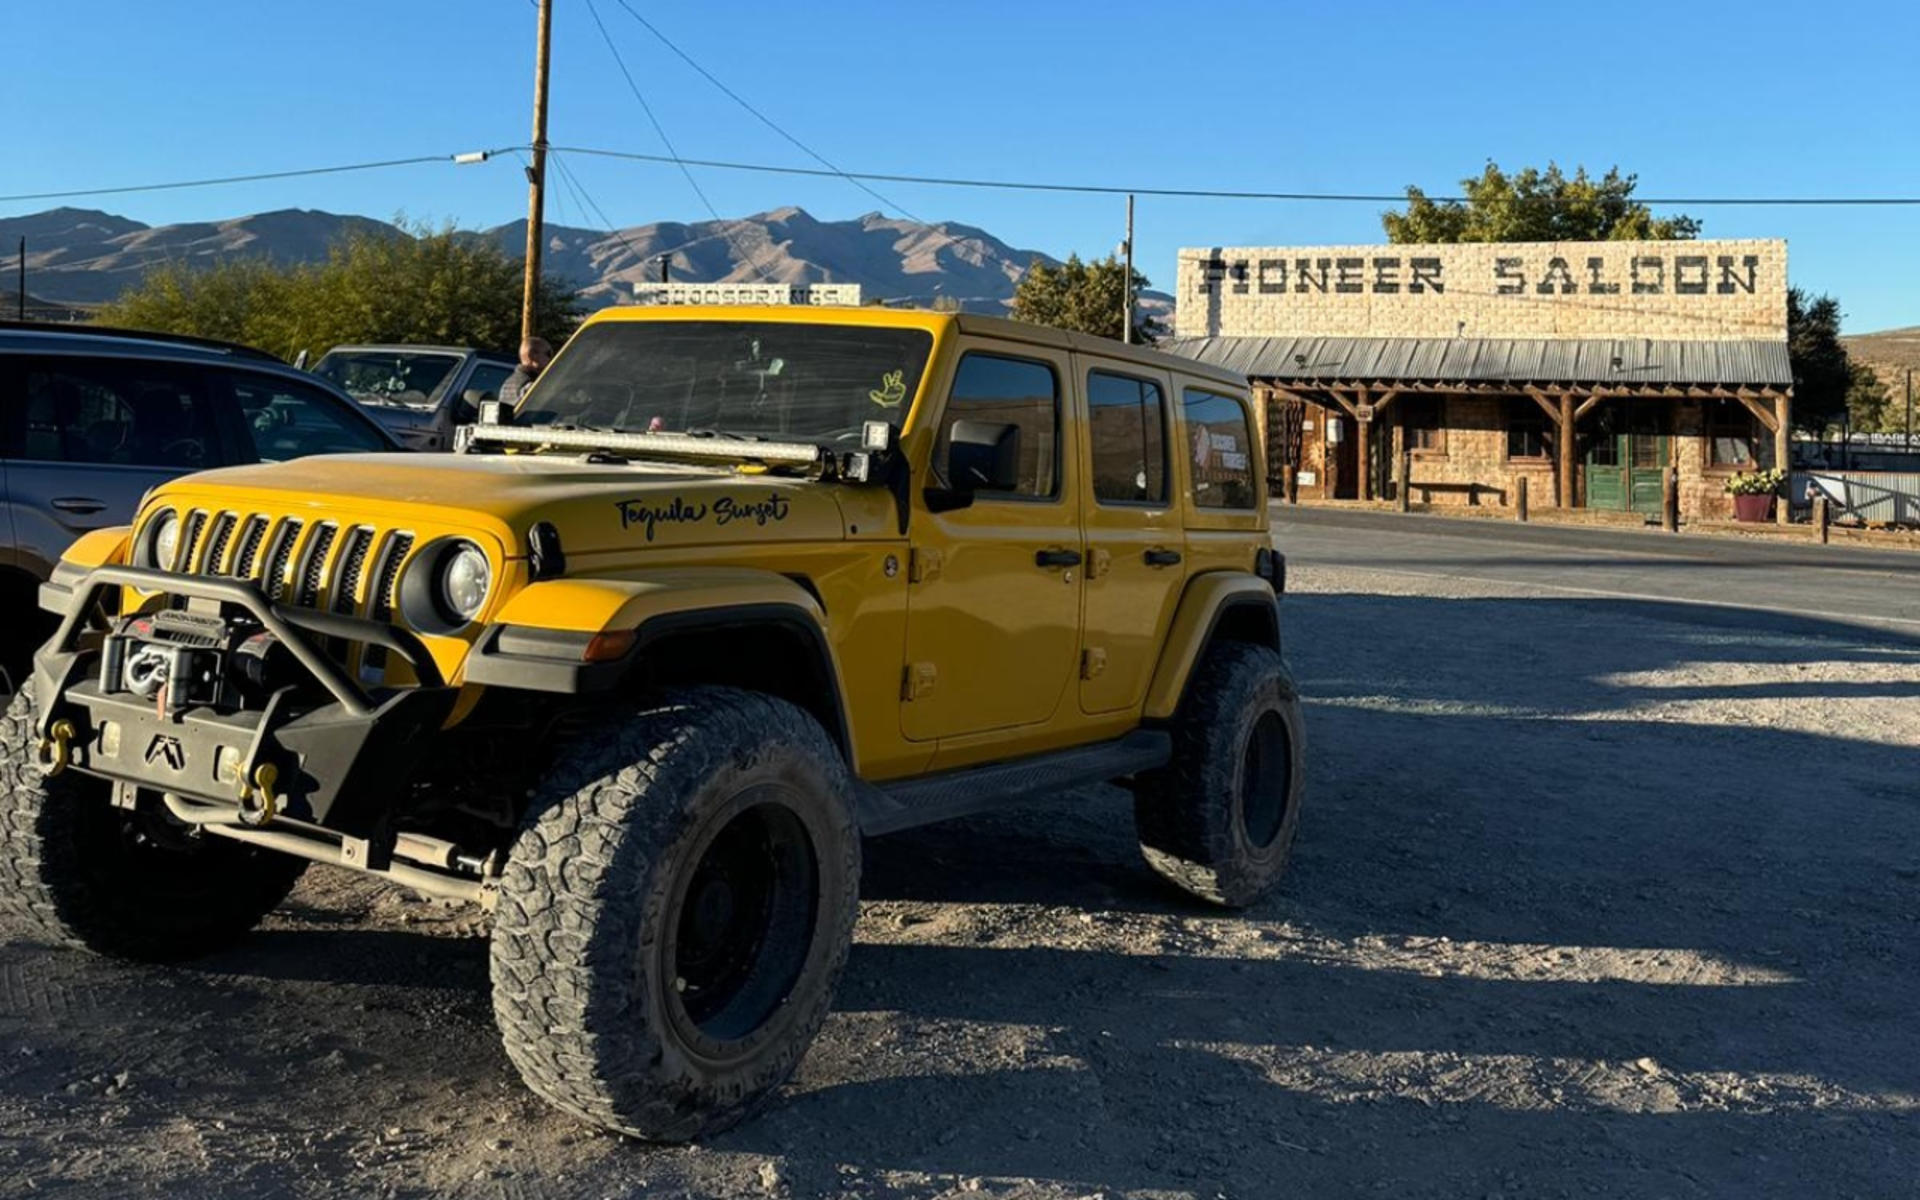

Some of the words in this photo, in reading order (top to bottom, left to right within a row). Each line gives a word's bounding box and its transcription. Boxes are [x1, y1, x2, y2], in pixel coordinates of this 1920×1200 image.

[1198, 257, 1444, 295] PIONEER
[1495, 255, 1760, 295] SALOON
[614, 497, 707, 541] Tequila
[713, 493, 790, 526] Sunset
